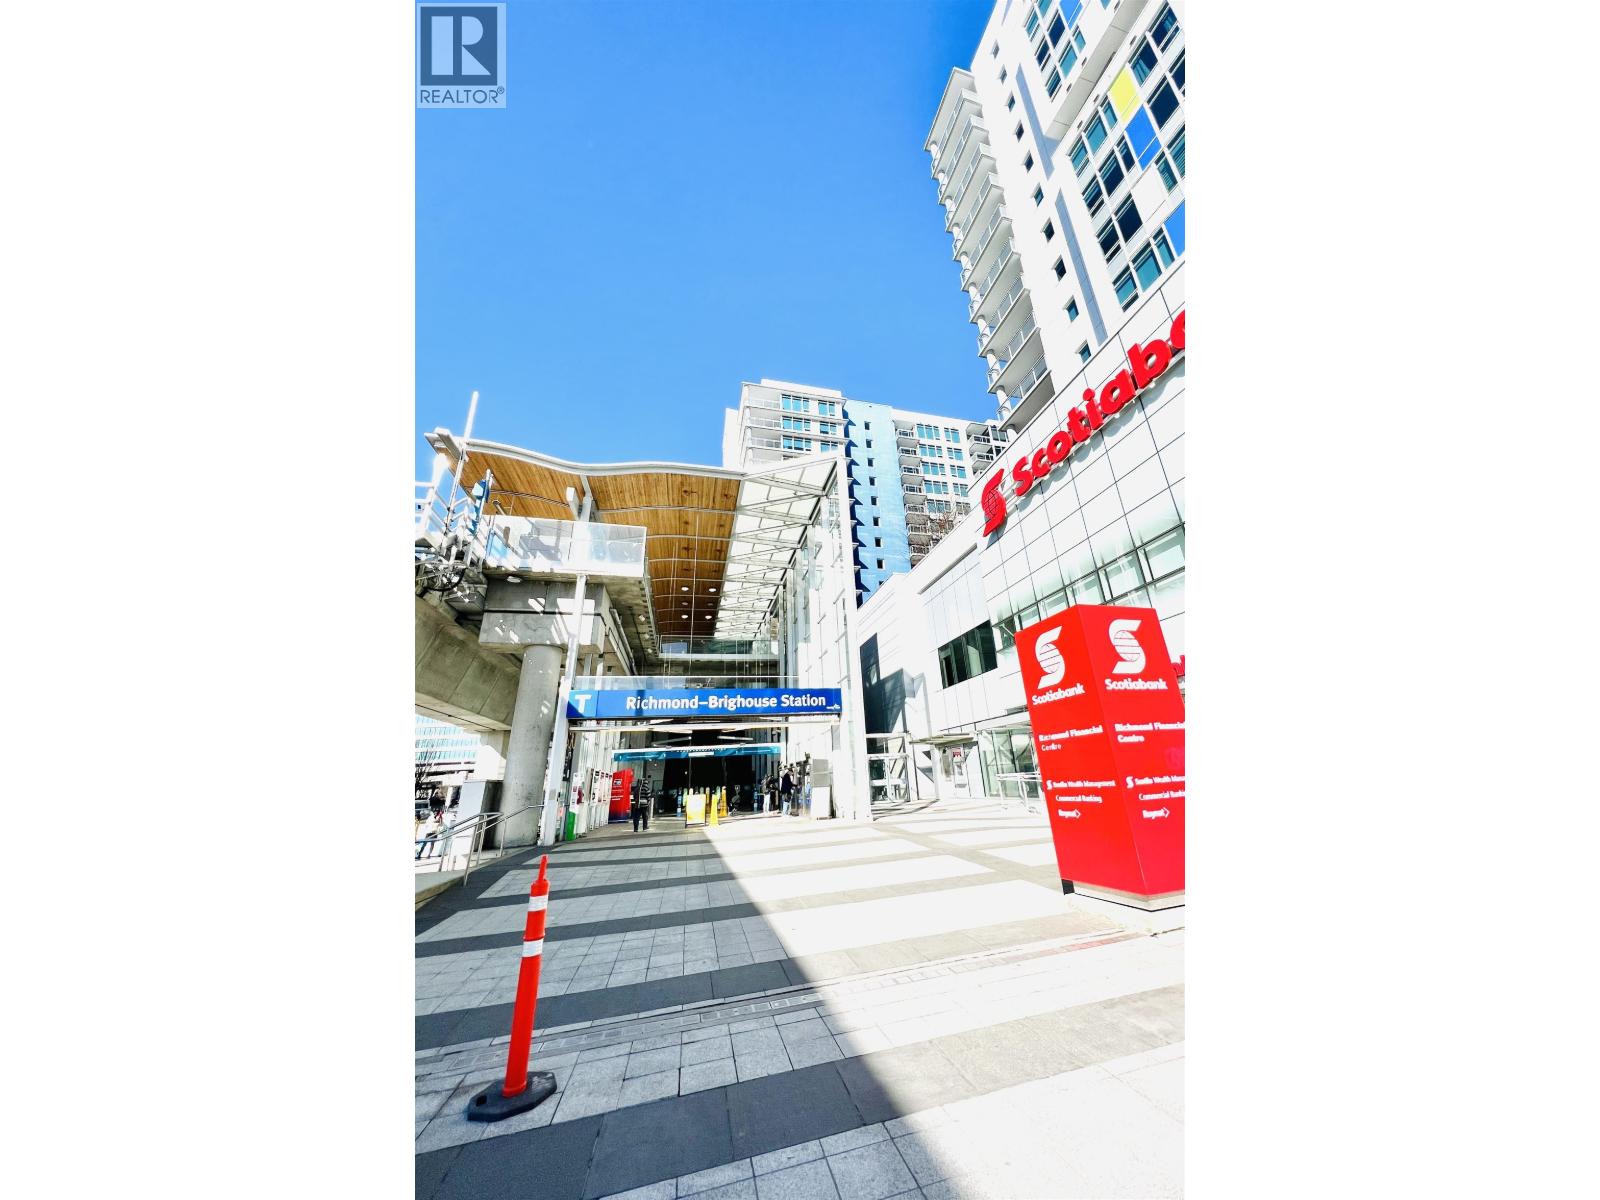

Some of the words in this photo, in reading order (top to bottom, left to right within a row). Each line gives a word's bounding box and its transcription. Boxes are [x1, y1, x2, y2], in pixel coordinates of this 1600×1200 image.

[1104, 677, 1169, 690] Scotiabank
[574, 694, 592, 714] T
[781, 693, 826, 707] Station
[1031, 683, 1086, 706] Scotiabank
